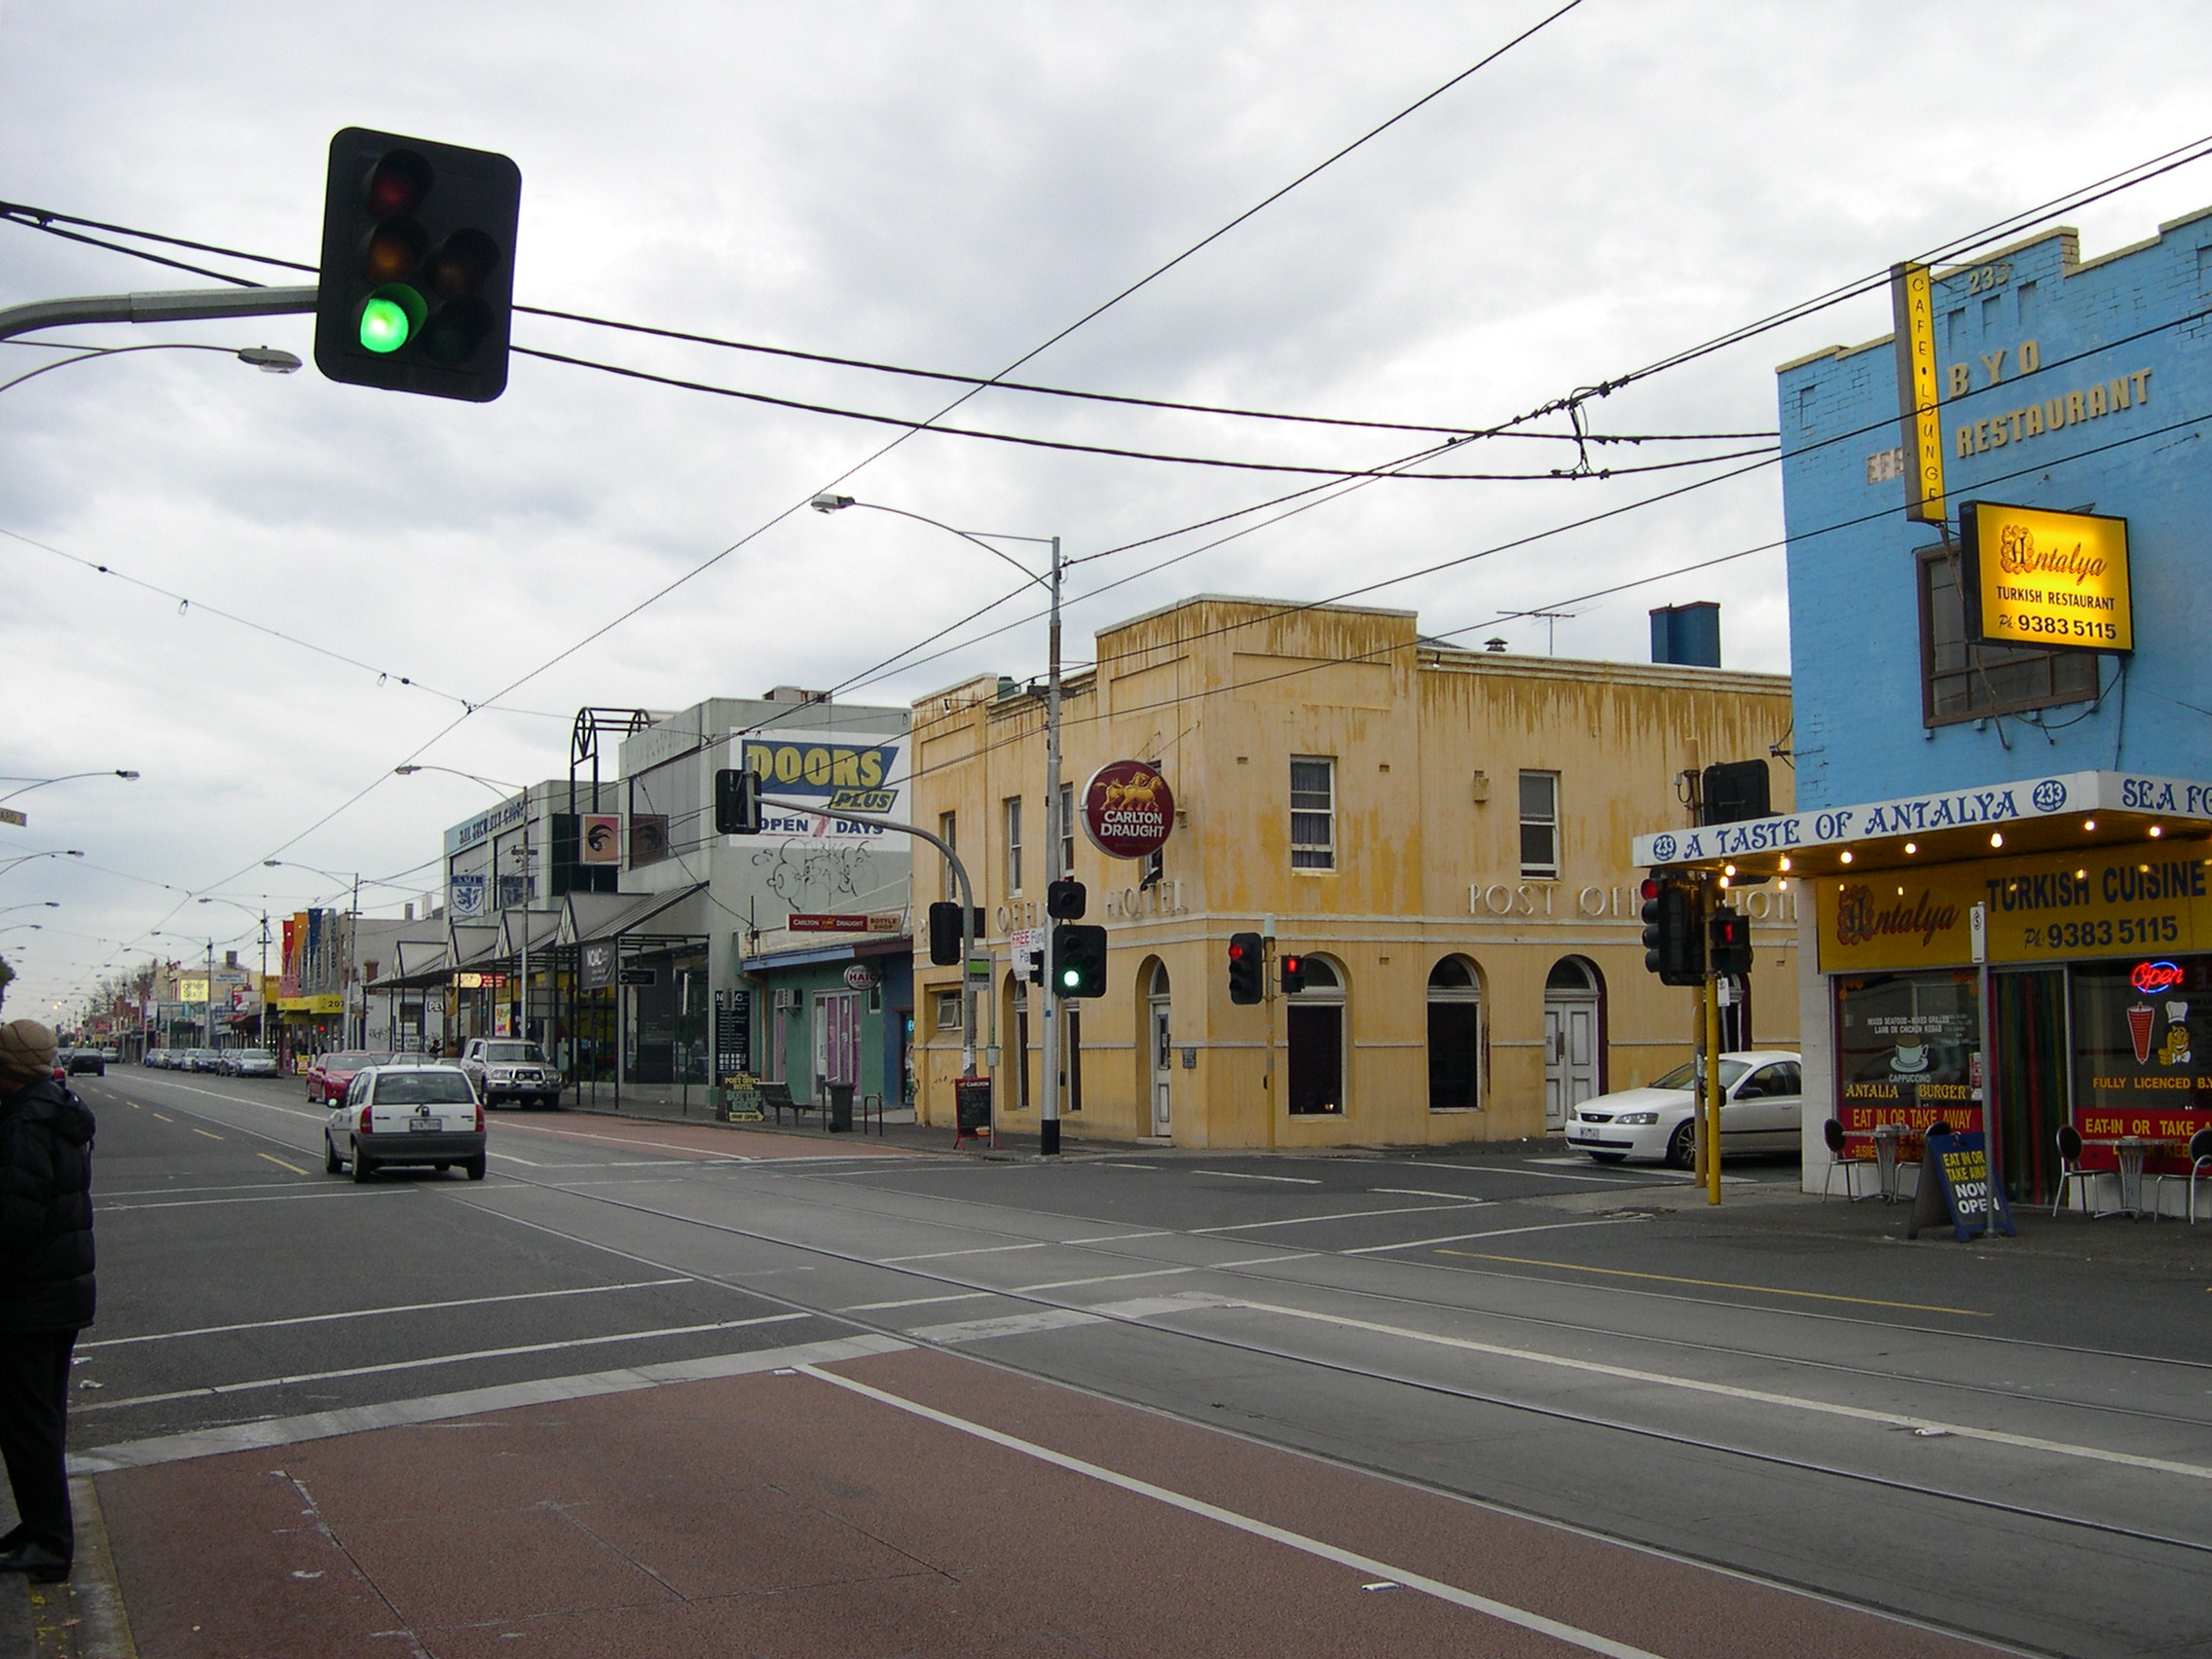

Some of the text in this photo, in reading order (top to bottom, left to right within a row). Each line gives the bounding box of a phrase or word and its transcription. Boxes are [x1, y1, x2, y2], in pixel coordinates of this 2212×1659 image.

[1968, 264, 2010, 295] 233
[1911, 277, 1938, 502] CAFE LOUNGE
[1956, 367, 2152, 459] RESTAURANT
[2001, 525, 2108, 585] Antalya
[1997, 585, 2115, 610] TURKISH RESTAURANT
[2018, 614, 2069, 635] 9383
[2074, 620, 2117, 640] 5115
[747, 745, 890, 809] DOORS PLUS
[2036, 782, 2063, 804] 233
[2122, 778, 2177, 812] SEA
[761, 815, 883, 838] OPEN 7 DAYS
[1104, 810, 1162, 824] CARLTON
[1683, 834, 1704, 859] A
[1715, 819, 1800, 856] TASTE
[1815, 811, 1853, 841] OF
[1864, 791, 2019, 834] ANTALYA
[1100, 823, 1164, 837] DRAUGHT
[1986, 860, 2207, 912] TURKISH CUISINE
[1469, 884, 1554, 915] POST
[2047, 920, 2113, 949] 9383
[2119, 915, 2178, 944] 5115
[2130, 961, 2184, 993] Open
[1846, 1084, 1967, 1100] ANTALIA BURGER
[2093, 1078, 2126, 1089] FULLY
[2134, 1078, 2191, 1089] LICENCED
[1853, 1109, 1972, 1129] EAT IN OR TAKE AWAY
[2132, 1119, 2150, 1135] OR
[2159, 1121, 2194, 1136] TAKE
[1942, 1150, 1986, 1167] EAT IN OR
[2163, 1143, 2189, 1159] KEB
[1945, 1165, 1987, 1182] TAKE AWA
[1955, 1182, 1987, 1198] NOW
